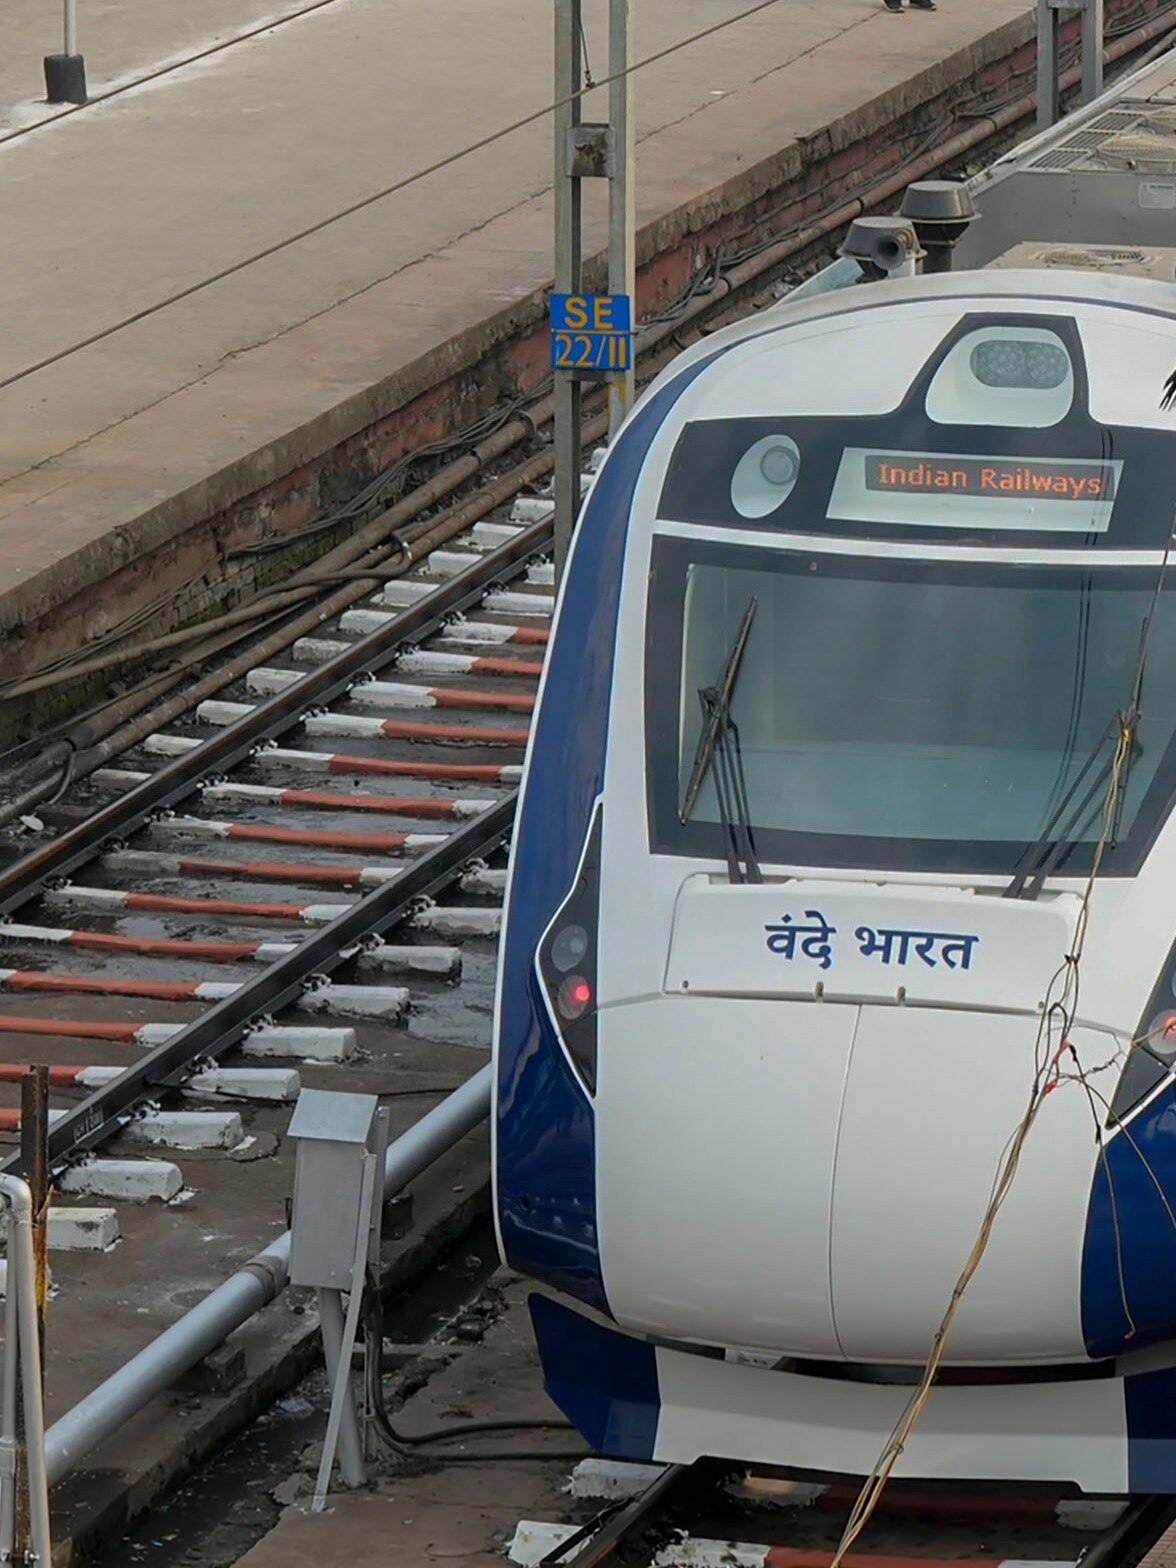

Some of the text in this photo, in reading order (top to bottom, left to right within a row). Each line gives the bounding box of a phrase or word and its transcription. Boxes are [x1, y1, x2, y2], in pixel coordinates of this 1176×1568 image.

[564, 296, 614, 329] SE
[555, 334, 627, 368] 22/11
[878, 463, 1103, 499] Indian Railways
[764, 909, 981, 970] वंदे भारत
